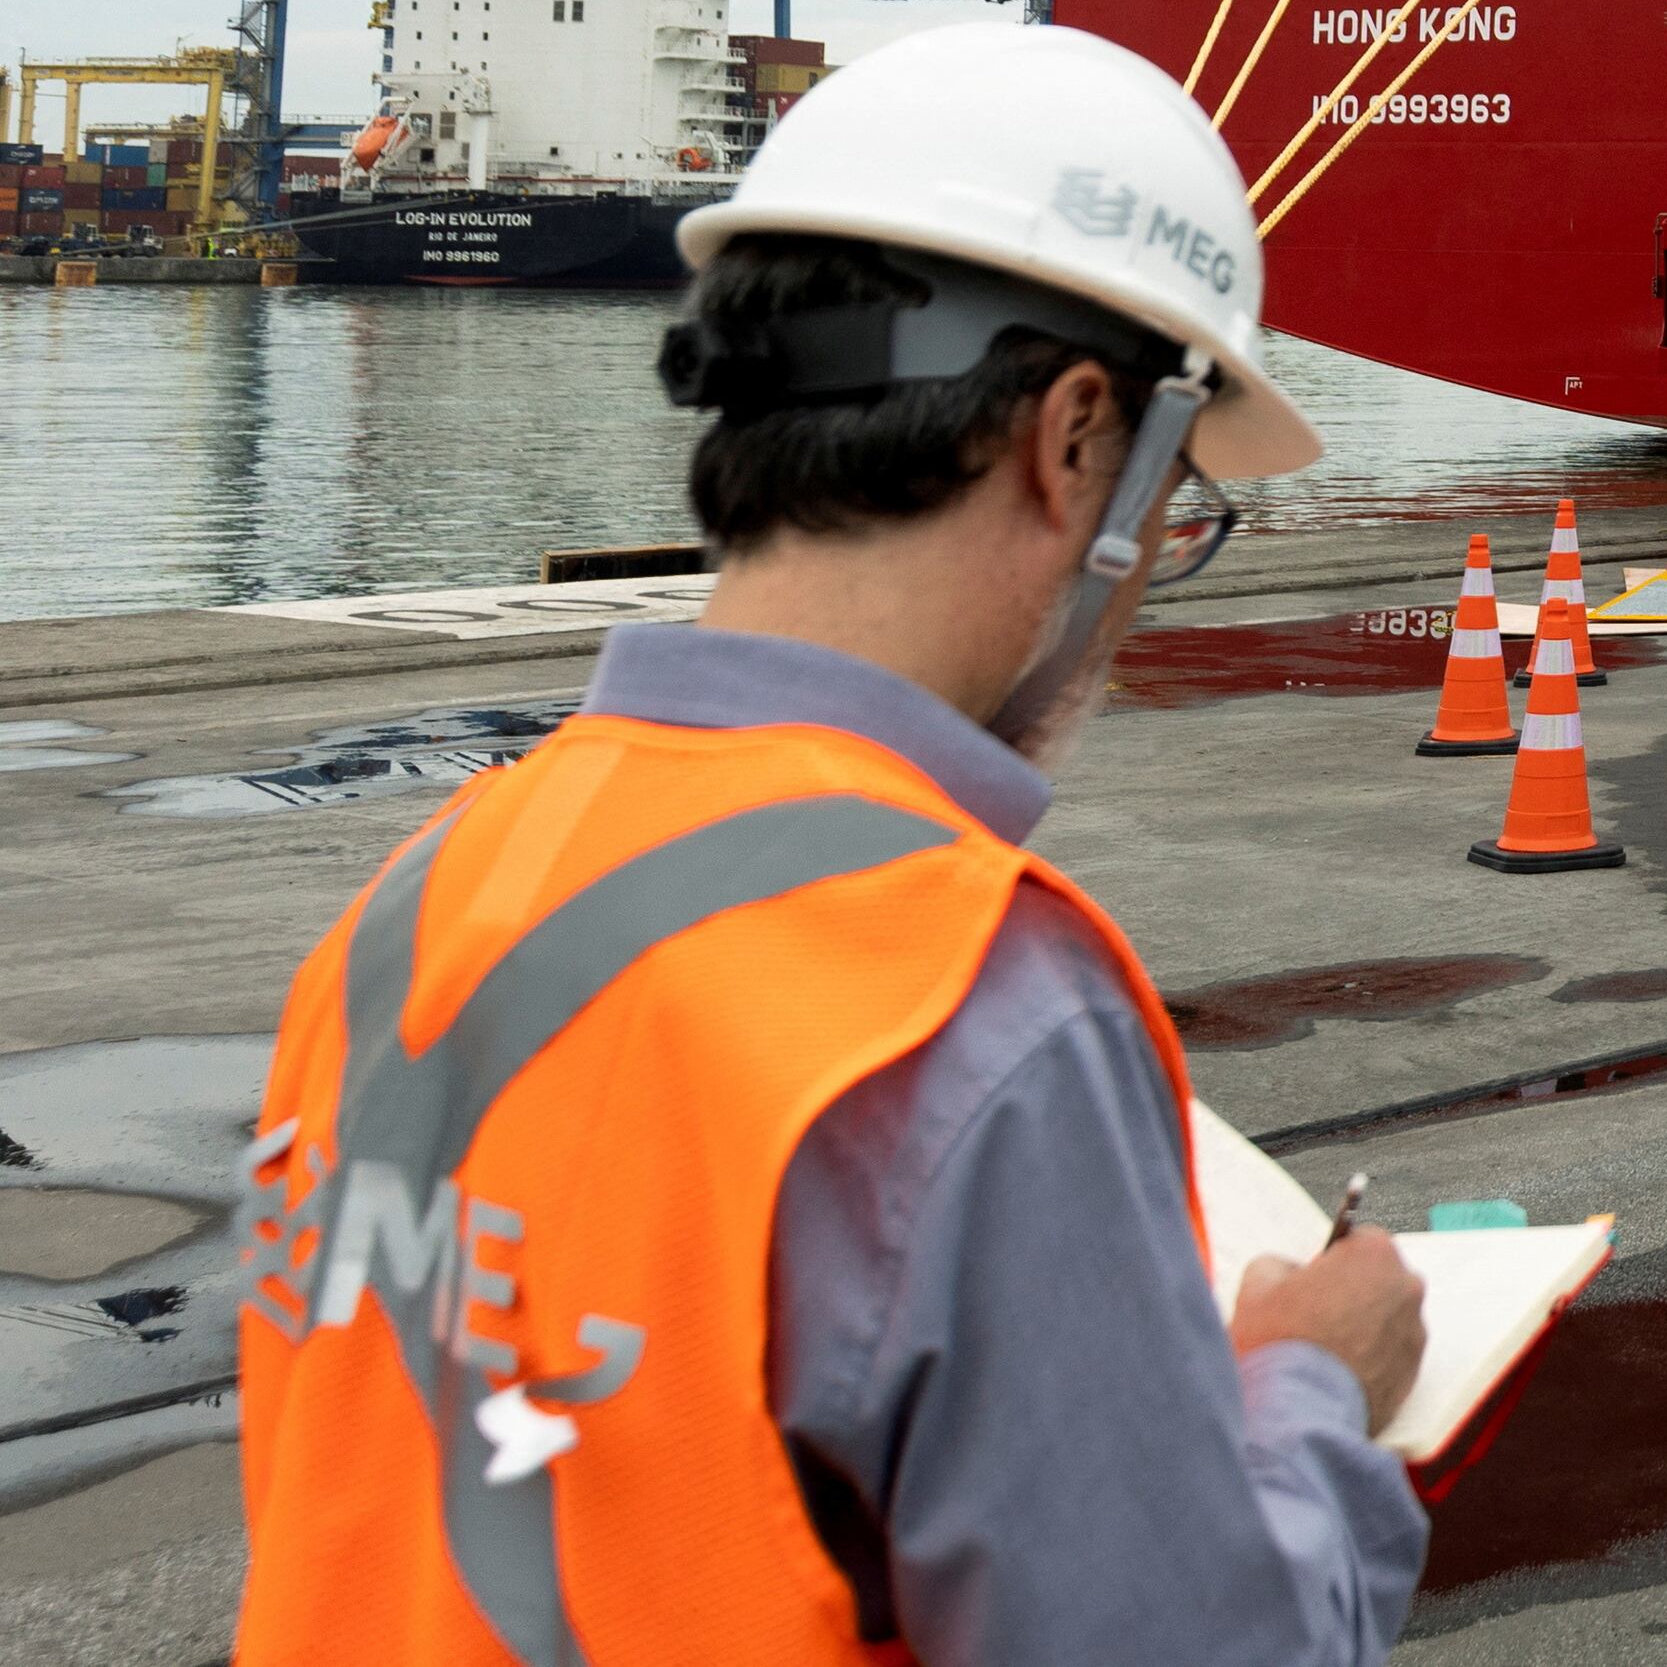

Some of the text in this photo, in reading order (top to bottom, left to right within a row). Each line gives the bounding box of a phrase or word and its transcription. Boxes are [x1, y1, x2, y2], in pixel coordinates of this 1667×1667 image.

[1312, 5, 1517, 45] HONG KONG
[1312, 93, 1511, 125] IMO 9993963
[395, 212, 532, 227] LOG-IN EVOLUTION
[428, 231, 498, 242] RIO DE JANEIRO
[423, 250, 444, 262] IMO
[1146, 203, 1237, 295] MEG
